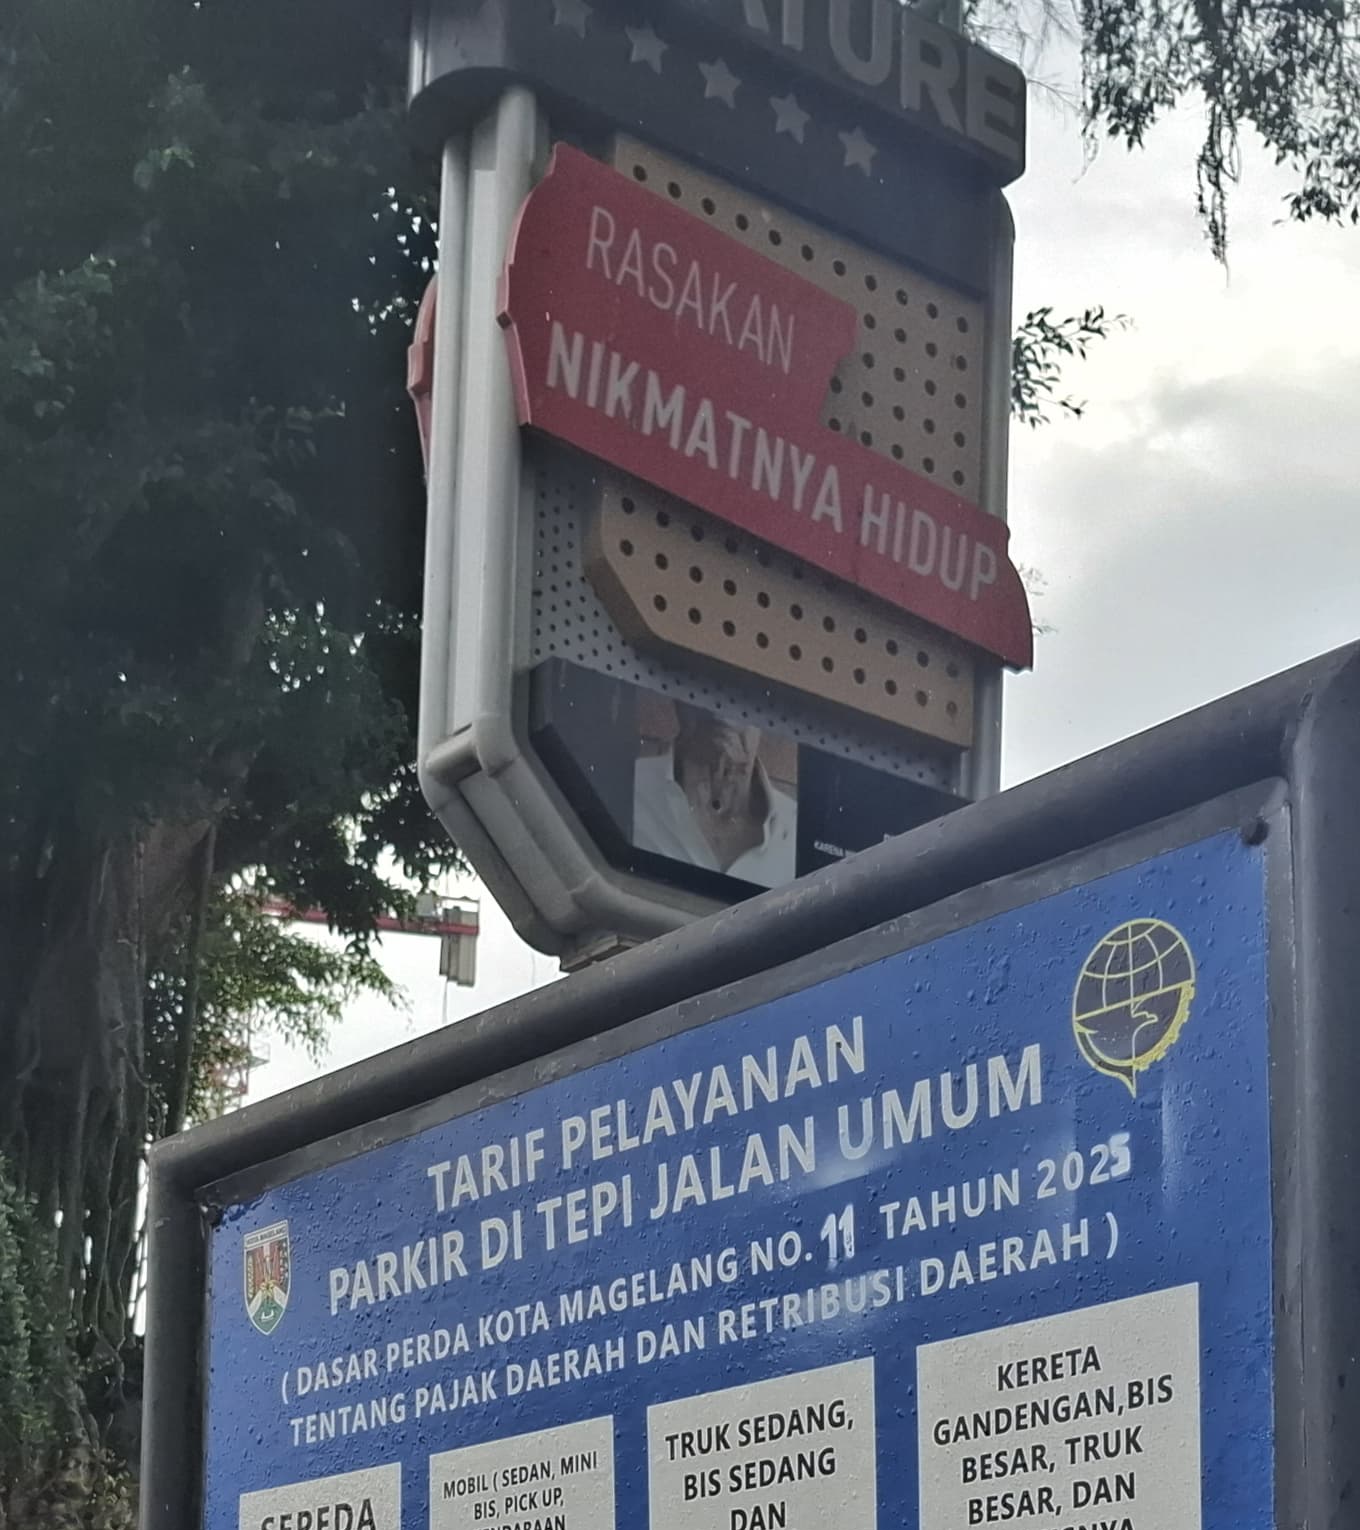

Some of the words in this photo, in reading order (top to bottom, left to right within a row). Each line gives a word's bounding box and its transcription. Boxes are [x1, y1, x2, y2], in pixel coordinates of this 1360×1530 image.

[586, 205, 796, 374] RASAKAN
[547, 322, 844, 533] NIKMATNYA
[860, 484, 999, 600] HIDUP
[427, 1128, 544, 1212] TARIF
[561, 1016, 865, 1170] PELAYANAN
[330, 1229, 467, 1316] PARKIR
[481, 1210, 523, 1270] DI
[537, 1174, 632, 1251] TEPI
[650, 1115, 816, 1220] JALAN
[838, 1043, 1042, 1161] UMUM
[297, 1349, 378, 1397] DASAR
[387, 1324, 469, 1374] PERDA
[479, 1301, 549, 1348] KOTA
[559, 1247, 738, 1326] MAGELANG
[751, 1231, 812, 1275] NO.
[820, 1204, 855, 1260] 11
[879, 1168, 1020, 1239] TAHUN
[1036, 1132, 1130, 1199] 2025
[290, 1397, 406, 1447] TENTANG
[416, 1369, 497, 1419] PAJAK
[506, 1337, 625, 1397] DAERAH
[637, 1318, 705, 1366] DAN
[718, 1266, 904, 1344] RETRIBUSI
[920, 1218, 1089, 1297] DAERAH
[997, 1345, 1101, 1391] KERETA
[665, 1423, 731, 1461] TRUK
[738, 1400, 853, 1448] SEDANG,
[962, 1443, 1056, 1484] BESAR,
[1064, 1425, 1143, 1465] TRUK
[444, 1474, 488, 1499] MOBIL
[502, 1461, 556, 1487] SEDAN,
[561, 1451, 597, 1475] MINI
[474, 1500, 500, 1520] BIS,
[505, 1491, 538, 1514] PICK
[542, 1487, 564, 1507] UP,
[684, 1469, 722, 1501] BIS
[729, 1447, 836, 1493] SEDANG
[968, 1486, 1062, 1525] BESAR,
[1072, 1471, 1135, 1509] DAN
